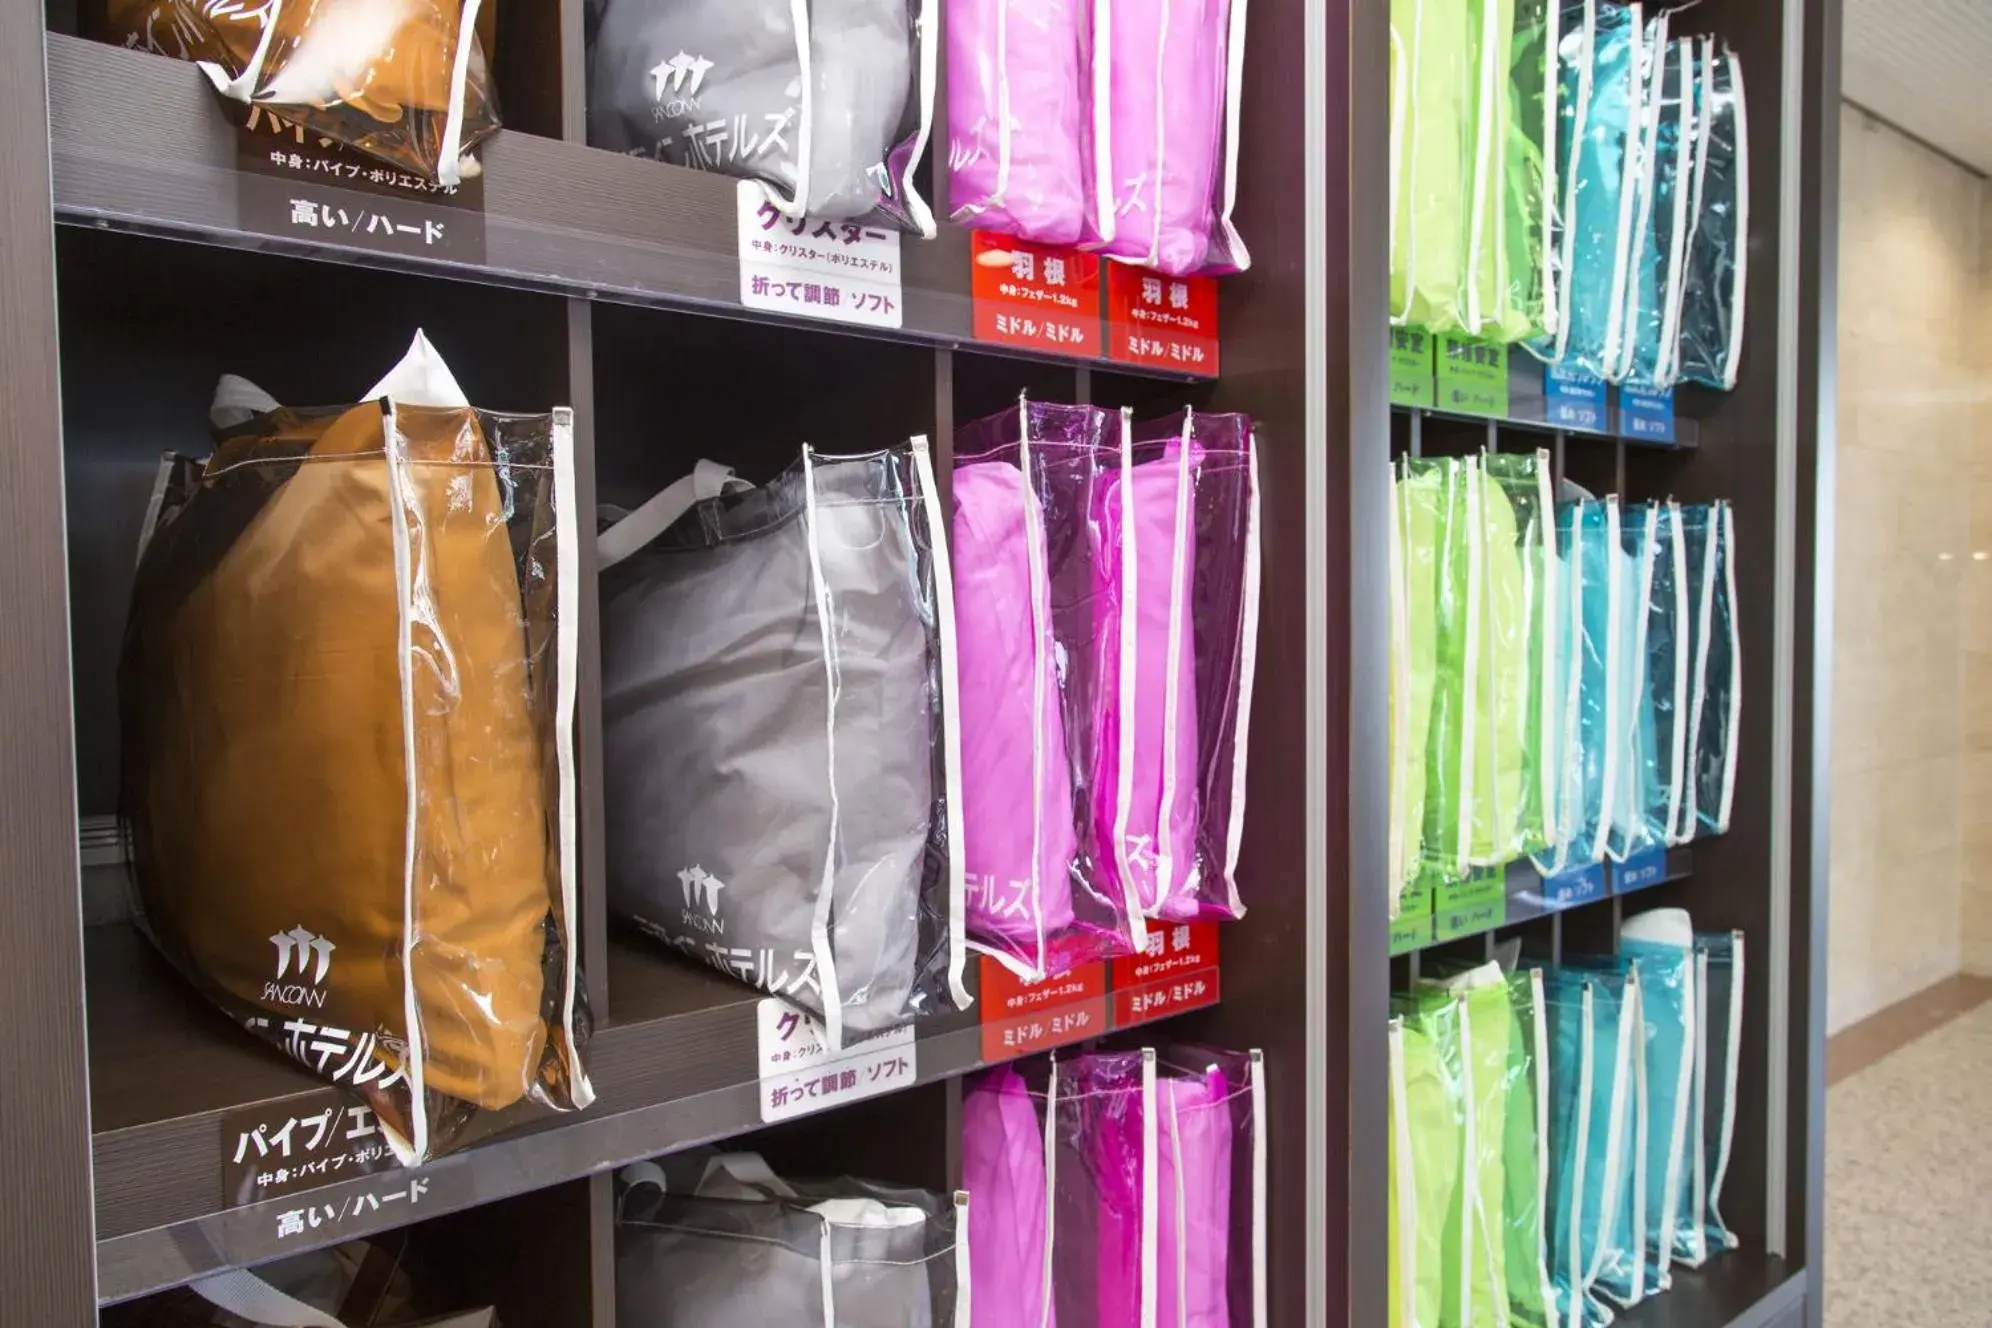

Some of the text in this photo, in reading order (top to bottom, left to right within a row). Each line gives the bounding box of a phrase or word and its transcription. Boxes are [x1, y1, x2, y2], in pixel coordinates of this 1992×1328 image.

[290, 199, 445, 245] 高い/ハード
[996, 314, 1084, 344] ミドル/ミドル
[1128, 336, 1205, 363] ミドル/ミドル
[1131, 980, 1206, 1013] ミドル/ミドル
[233, 1105, 384, 1164] パイプ/エ
[277, 1177, 430, 1239] 高い/ハード
